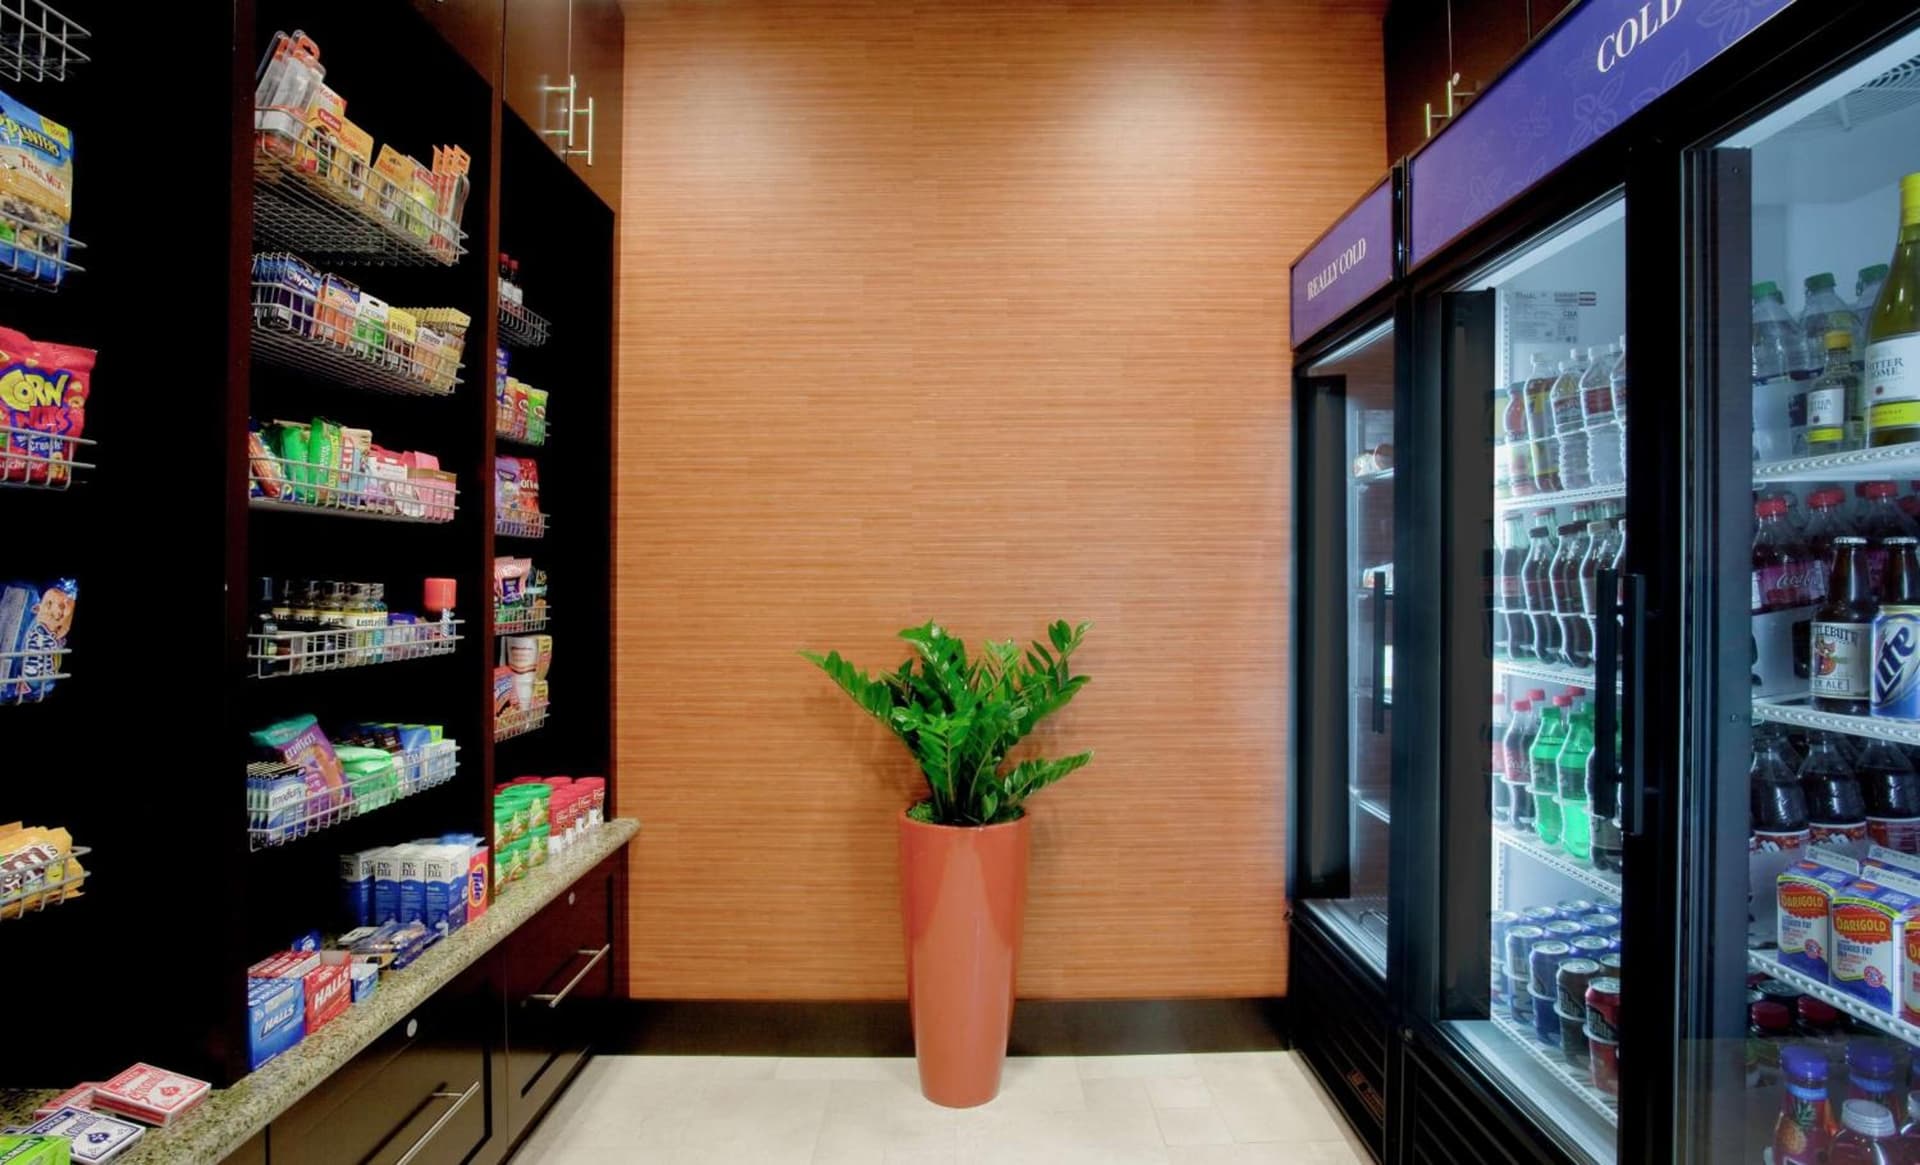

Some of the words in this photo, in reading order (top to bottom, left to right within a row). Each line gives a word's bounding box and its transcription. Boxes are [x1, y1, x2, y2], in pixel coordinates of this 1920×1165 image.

[1597, 0, 1682, 73] COLD
[1307, 259, 1339, 301] REALLY
[1339, 237, 1367, 275] COLD
[0, 369, 69, 412] CORN
[314, 967, 349, 1010] HALLS
[264, 1006, 294, 1034] HALLS
